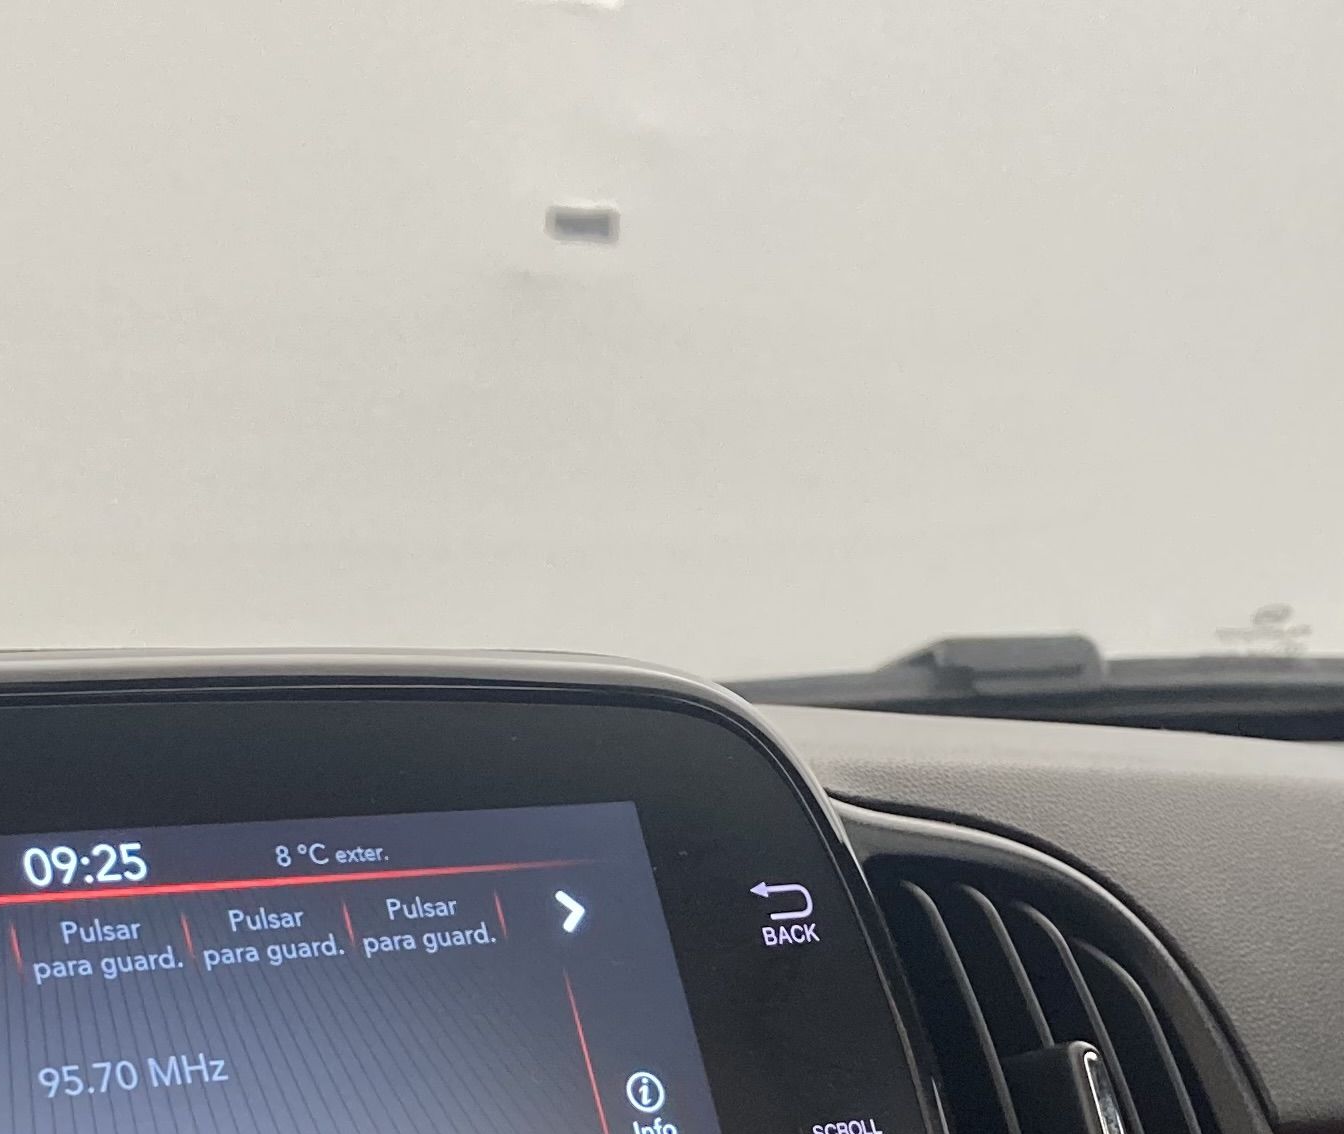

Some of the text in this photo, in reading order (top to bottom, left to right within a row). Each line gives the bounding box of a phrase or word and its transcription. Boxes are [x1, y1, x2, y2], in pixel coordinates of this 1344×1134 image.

[22, 843, 149, 888] 09:25
[335, 843, 390, 864] exter.
[228, 907, 305, 932] Pulsar
[386, 896, 457, 920] Pulsar
[60, 918, 141, 944] Pulsar
[362, 924, 497, 957] para guard.
[762, 924, 820, 946] BACK
[32, 947, 184, 983] para guard.
[202, 934, 345, 970] para guard.
[37, 1054, 229, 1099] 95.70 MHz
